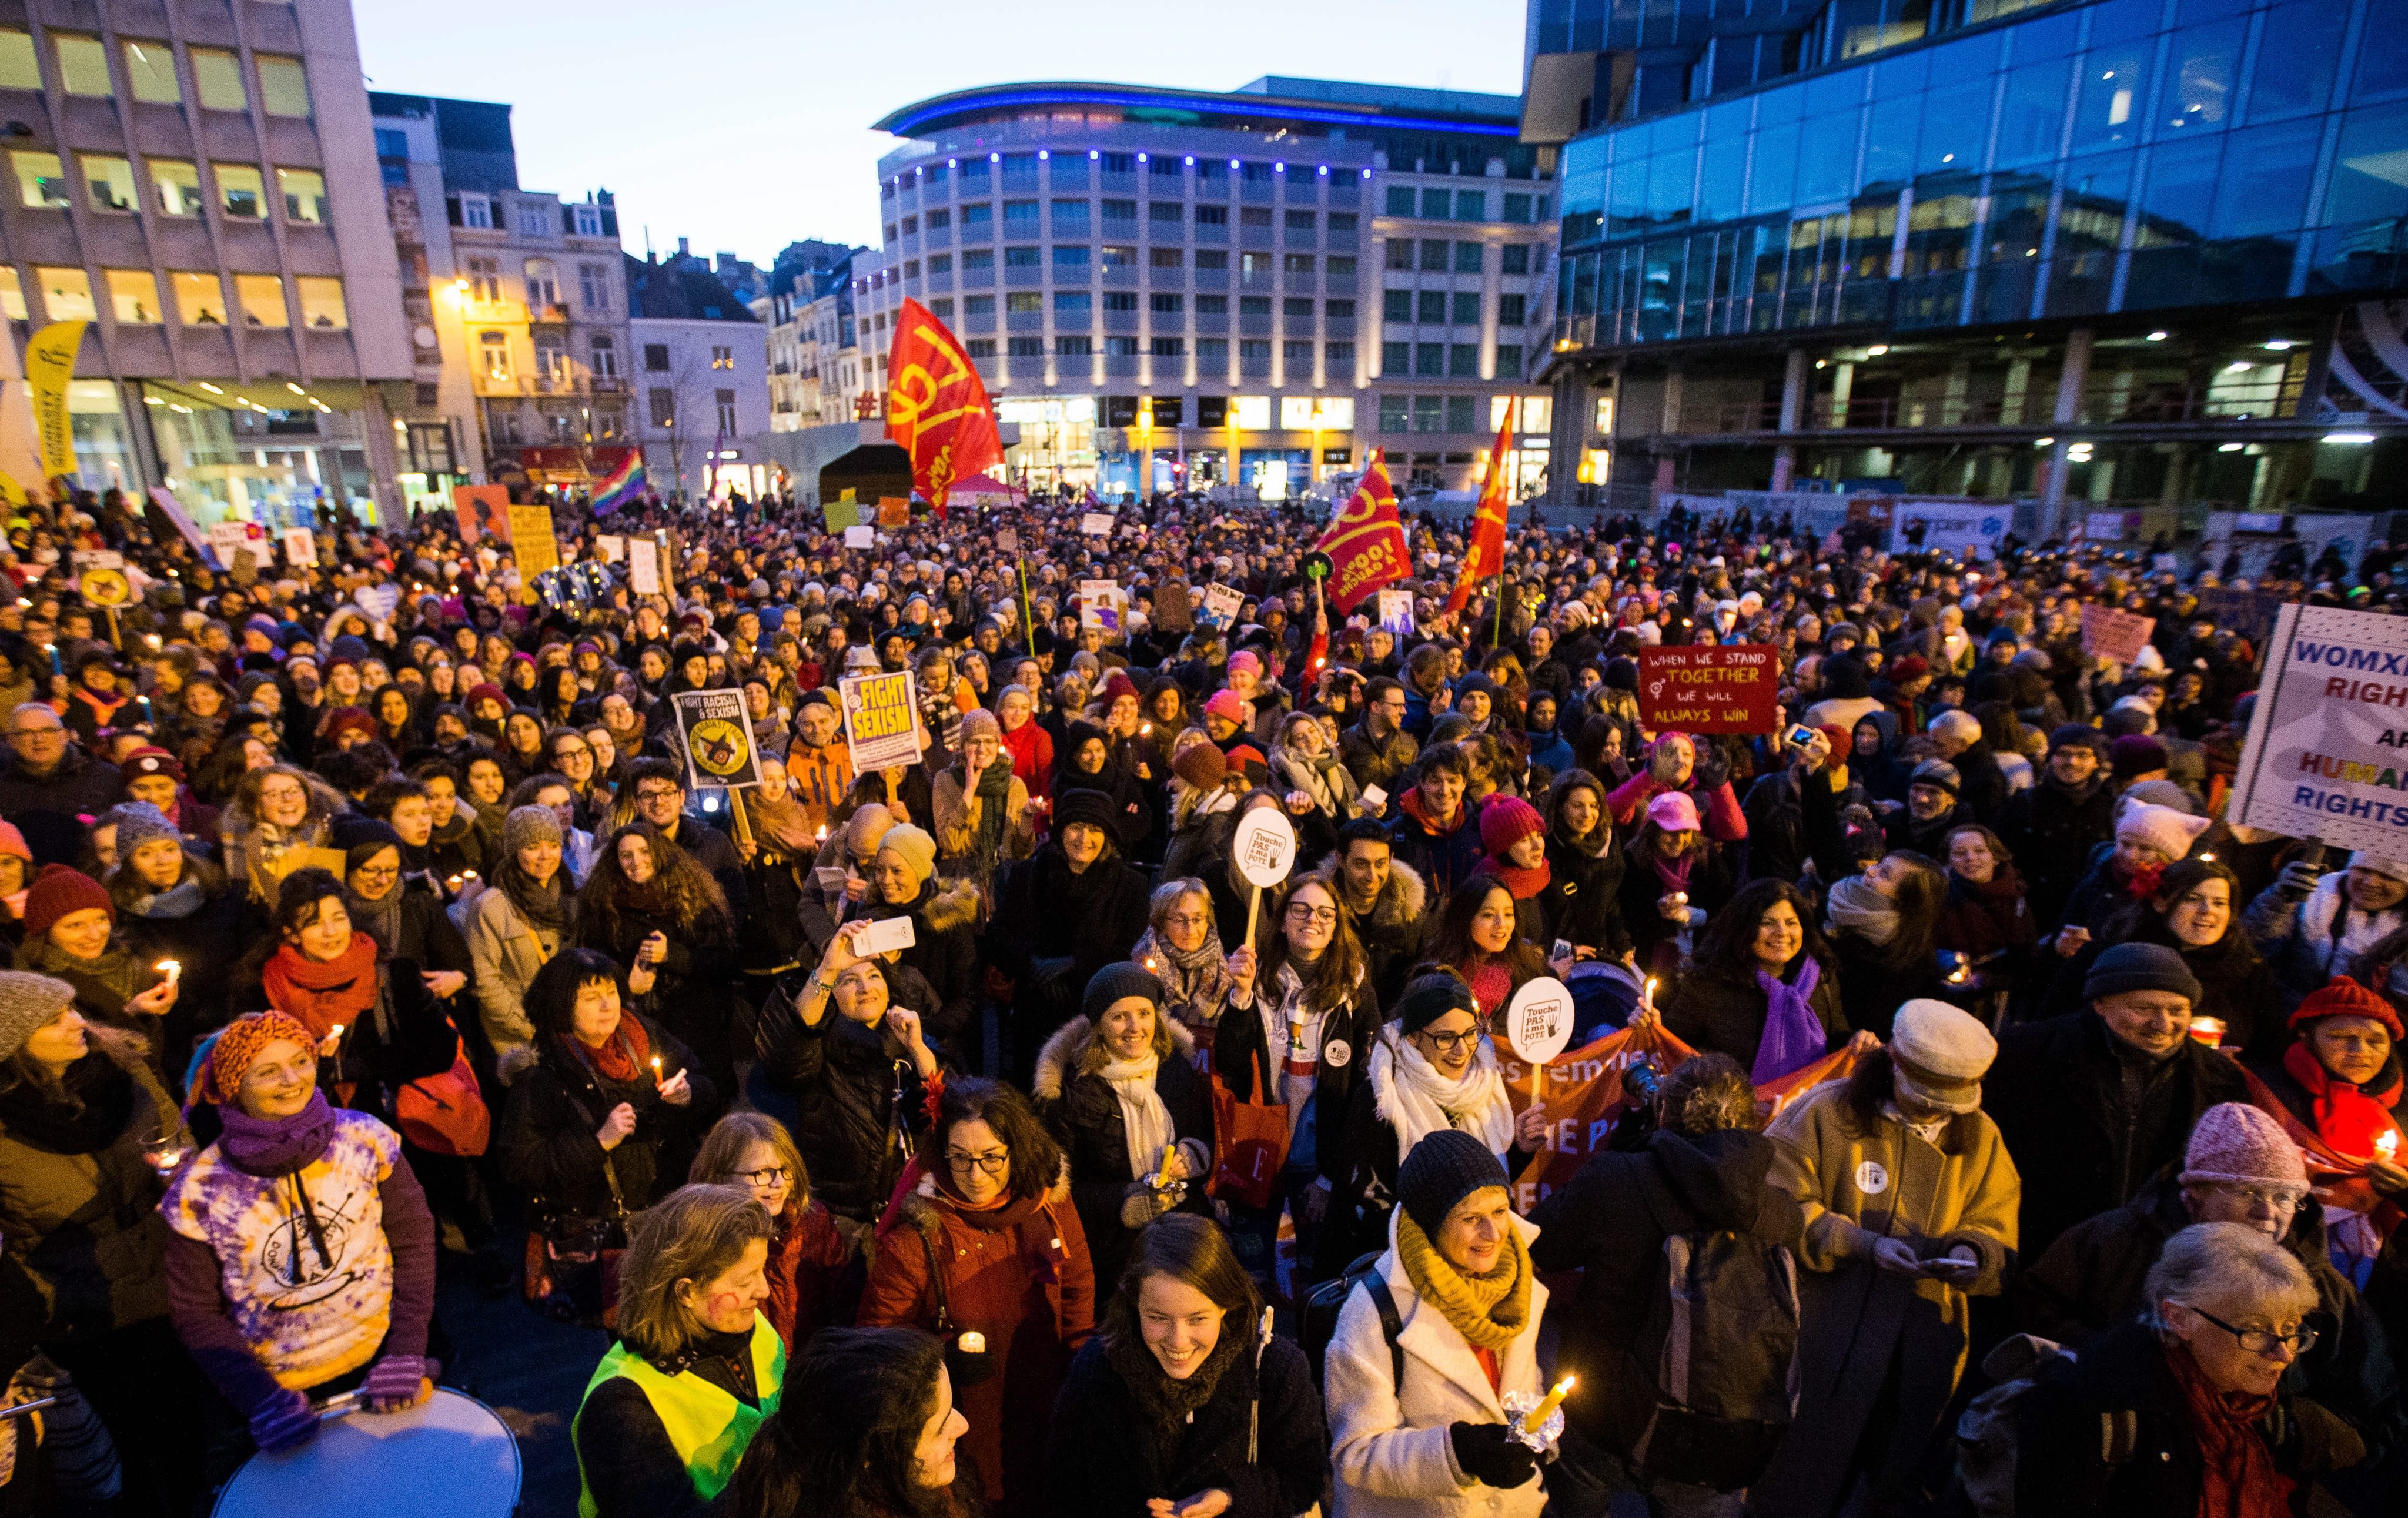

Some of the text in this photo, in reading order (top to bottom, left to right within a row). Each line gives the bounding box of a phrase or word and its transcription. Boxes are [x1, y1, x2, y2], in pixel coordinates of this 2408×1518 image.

[1648, 653, 1766, 667] WHEN WE STAND
[2296, 640, 2408, 676] WOMX
[1665, 667, 1760, 684] TOGETHER
[859, 675, 906, 710] FIGHT
[1676, 691, 1733, 702] WE WILL
[680, 694, 737, 708] FIGHT RACISM
[706, 705, 740, 719] SEXISM
[1654, 708, 1748, 723] ALWAYS WIN
[852, 704, 911, 740] SEXISM
[2295, 785, 2408, 827] RIGHTS
[1252, 840, 1269, 851] PAS
[1256, 832, 1283, 847] Touche
[1248, 854, 1267, 865] POTE
[1527, 1005, 1558, 1017] Touche
[1526, 1015, 1544, 1026] PAS
[1524, 1032, 1545, 1041] POTE
